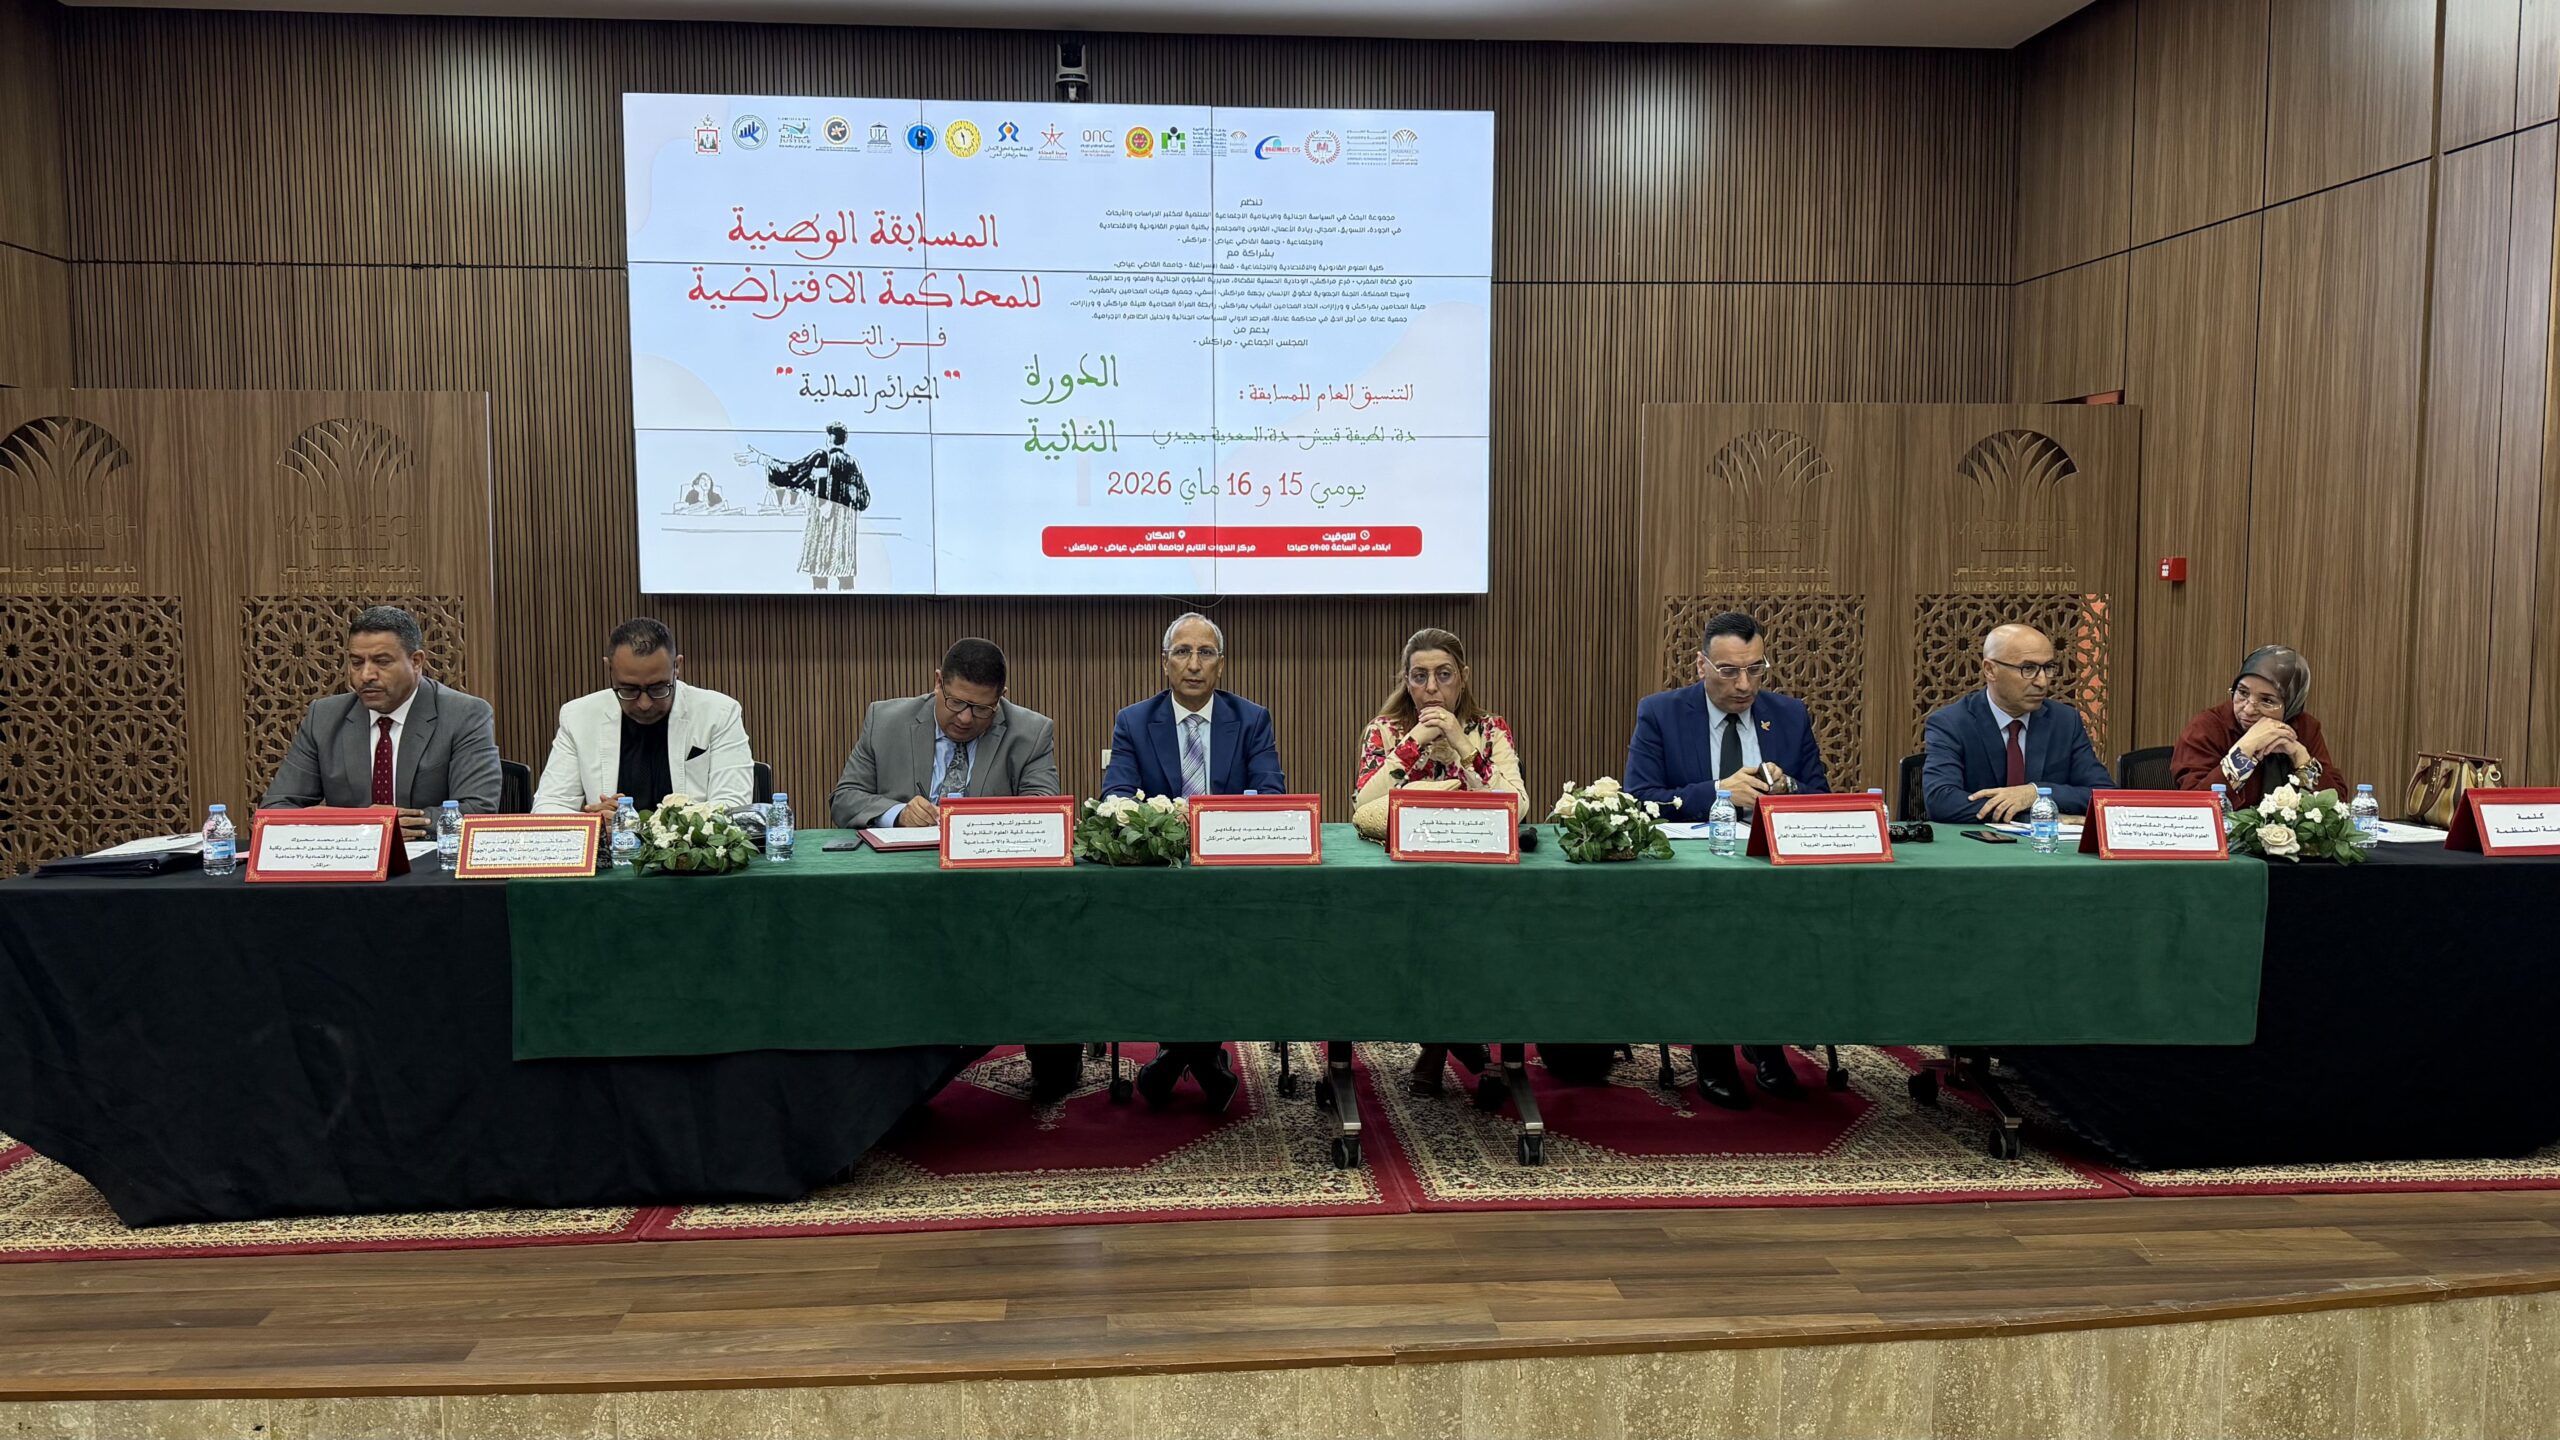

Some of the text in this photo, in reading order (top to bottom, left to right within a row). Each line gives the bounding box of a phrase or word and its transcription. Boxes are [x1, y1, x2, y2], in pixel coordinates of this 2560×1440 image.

[727, 206, 999, 260] المسابقة الوطنية
[687, 266, 1042, 320] للمحاكمة الافتراضية
[788, 324, 947, 359] فن الترافع
[1020, 353, 1119, 405] الدورة
[799, 373, 940, 413] الجرائم المالية
[1249, 383, 1414, 412] التنسيق العام للمسابقة
[1024, 417, 1118, 460] الثانية
[1107, 467, 1366, 510] يومي 15 و 16 ماي 2026
[1145, 531, 1175, 541] المكان
[1321, 532, 1356, 541] التوقيت
[1068, 543, 1098, 552] مراكش
[1331, 543, 1357, 551] الساعة
[1358, 544, 1370, 552] من
[0, 582, 140, 594] NIVERSITE CADI AYYAD
[1703, 582, 1766, 593] UNIVERSITE
[1797, 582, 1830, 593] AYYAD
[1953, 581, 2015, 592] UNIVERSITE
[2044, 581, 2077, 592] AYYAD
